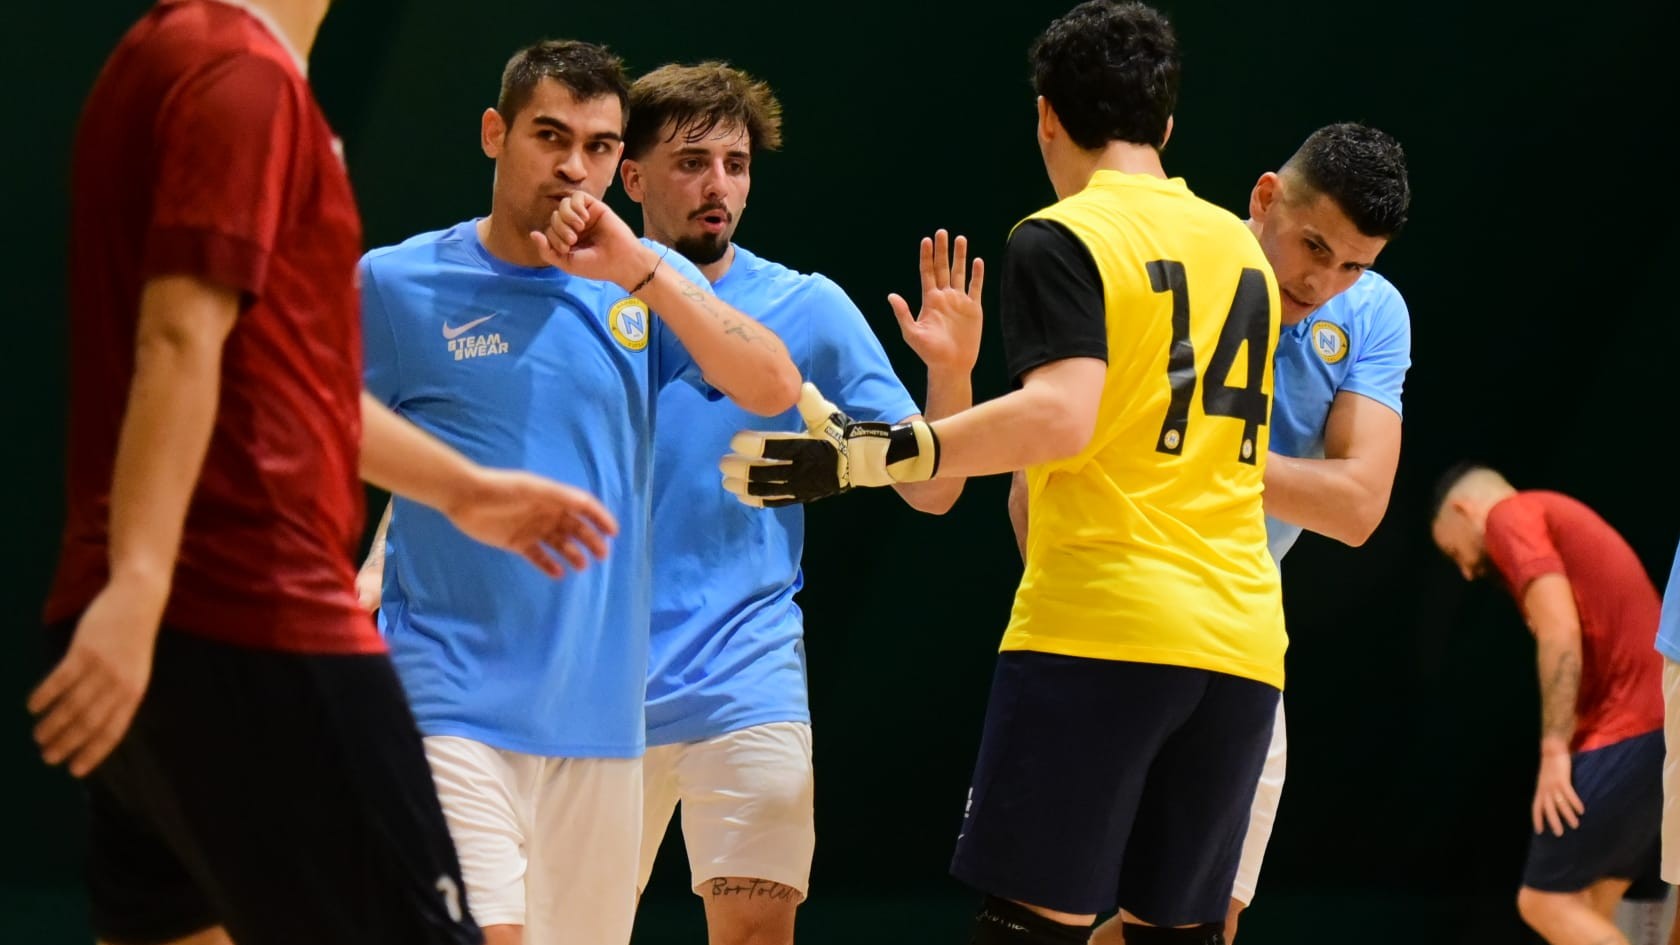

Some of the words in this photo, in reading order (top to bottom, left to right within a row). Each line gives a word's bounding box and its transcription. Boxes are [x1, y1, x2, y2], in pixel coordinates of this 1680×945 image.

[620, 311, 644, 335] N
[457, 333, 501, 351] TEAM
[464, 342, 509, 359] WEAR
[1319, 330, 1336, 354] N
[1145, 259, 1271, 466] 14
